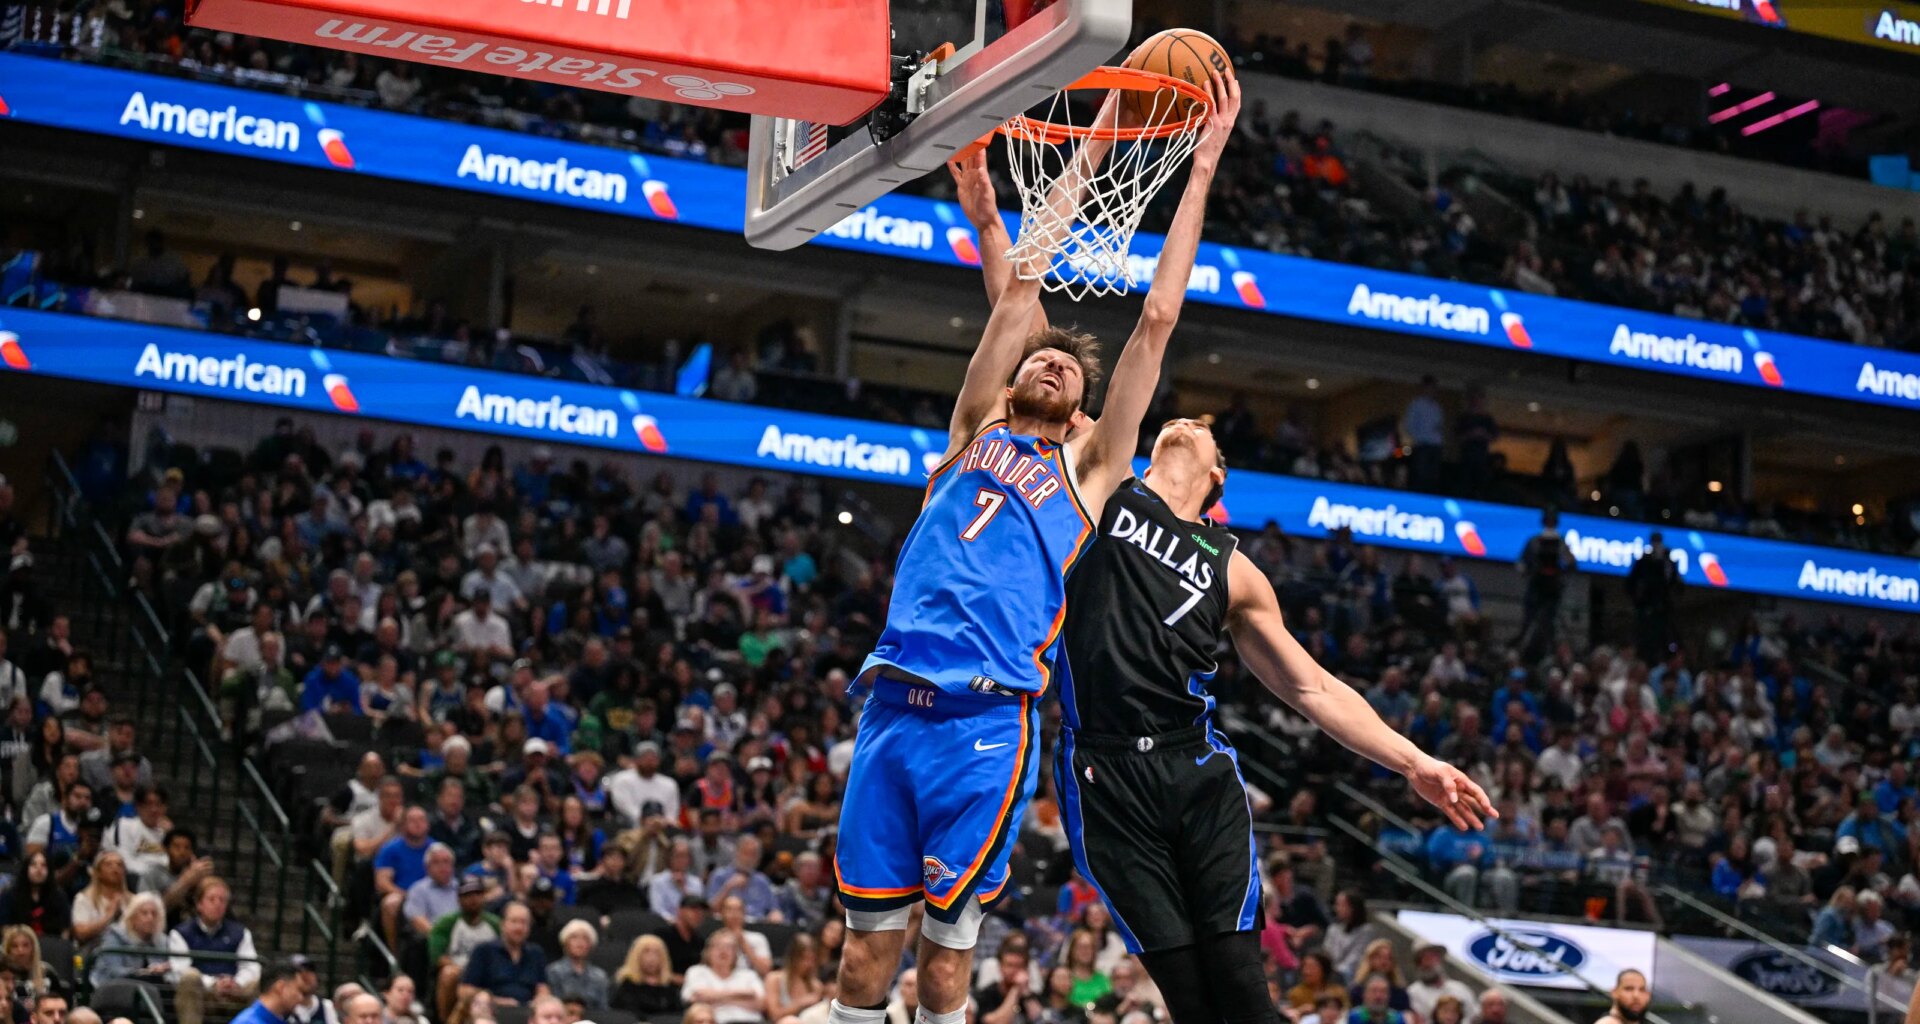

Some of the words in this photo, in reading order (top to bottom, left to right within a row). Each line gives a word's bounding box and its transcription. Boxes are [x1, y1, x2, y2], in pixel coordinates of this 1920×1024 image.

[120, 92, 300, 151] American
[458, 144, 627, 204] American
[823, 206, 934, 250] erican
[1348, 283, 1489, 334] American
[135, 343, 306, 396] American
[1610, 324, 1743, 373] American
[1856, 361, 1920, 400] Ame
[457, 385, 619, 438] American
[758, 425, 911, 476] American
[958, 440, 1062, 510] THUNDER
[959, 487, 1008, 542] 7
[1308, 496, 1444, 542] American
[1108, 506, 1214, 590] DALLAS
[1191, 533, 1220, 557] chime
[1565, 529, 1688, 575] Amerin
[1163, 579, 1205, 626] 7
[1798, 560, 1919, 603] American
[908, 688, 935, 707] OKC
[1486, 933, 1567, 973] Ford
